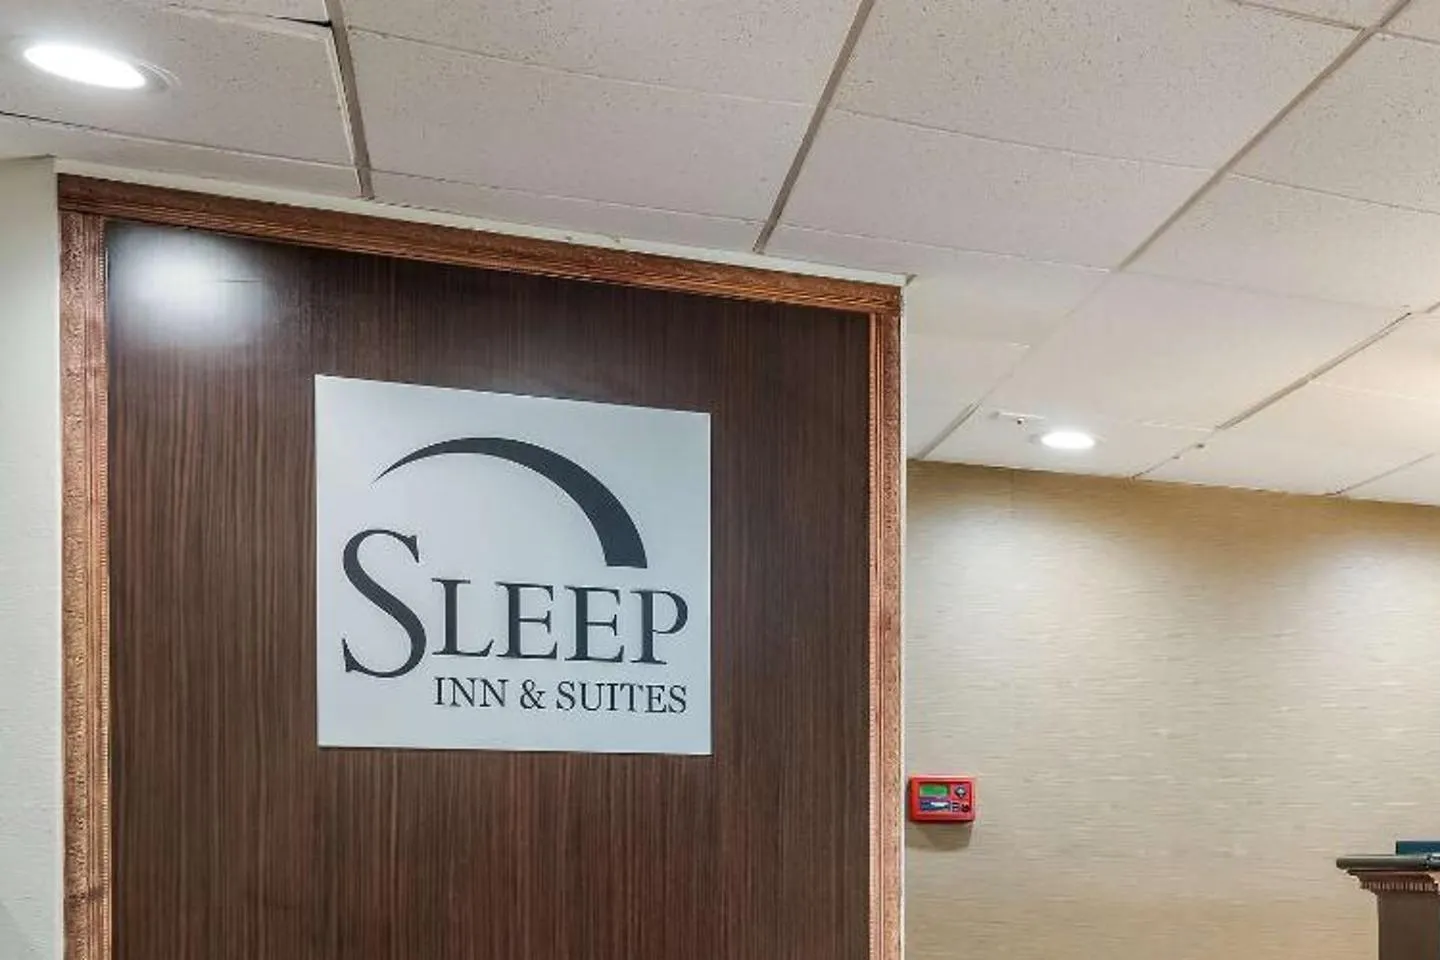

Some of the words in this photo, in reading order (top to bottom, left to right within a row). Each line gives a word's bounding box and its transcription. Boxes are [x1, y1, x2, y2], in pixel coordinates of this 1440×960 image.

[341, 528, 689, 678] SLEEP
[433, 676, 509, 708] INN
[519, 680, 547, 710] &
[555, 680, 688, 714] SUITES
